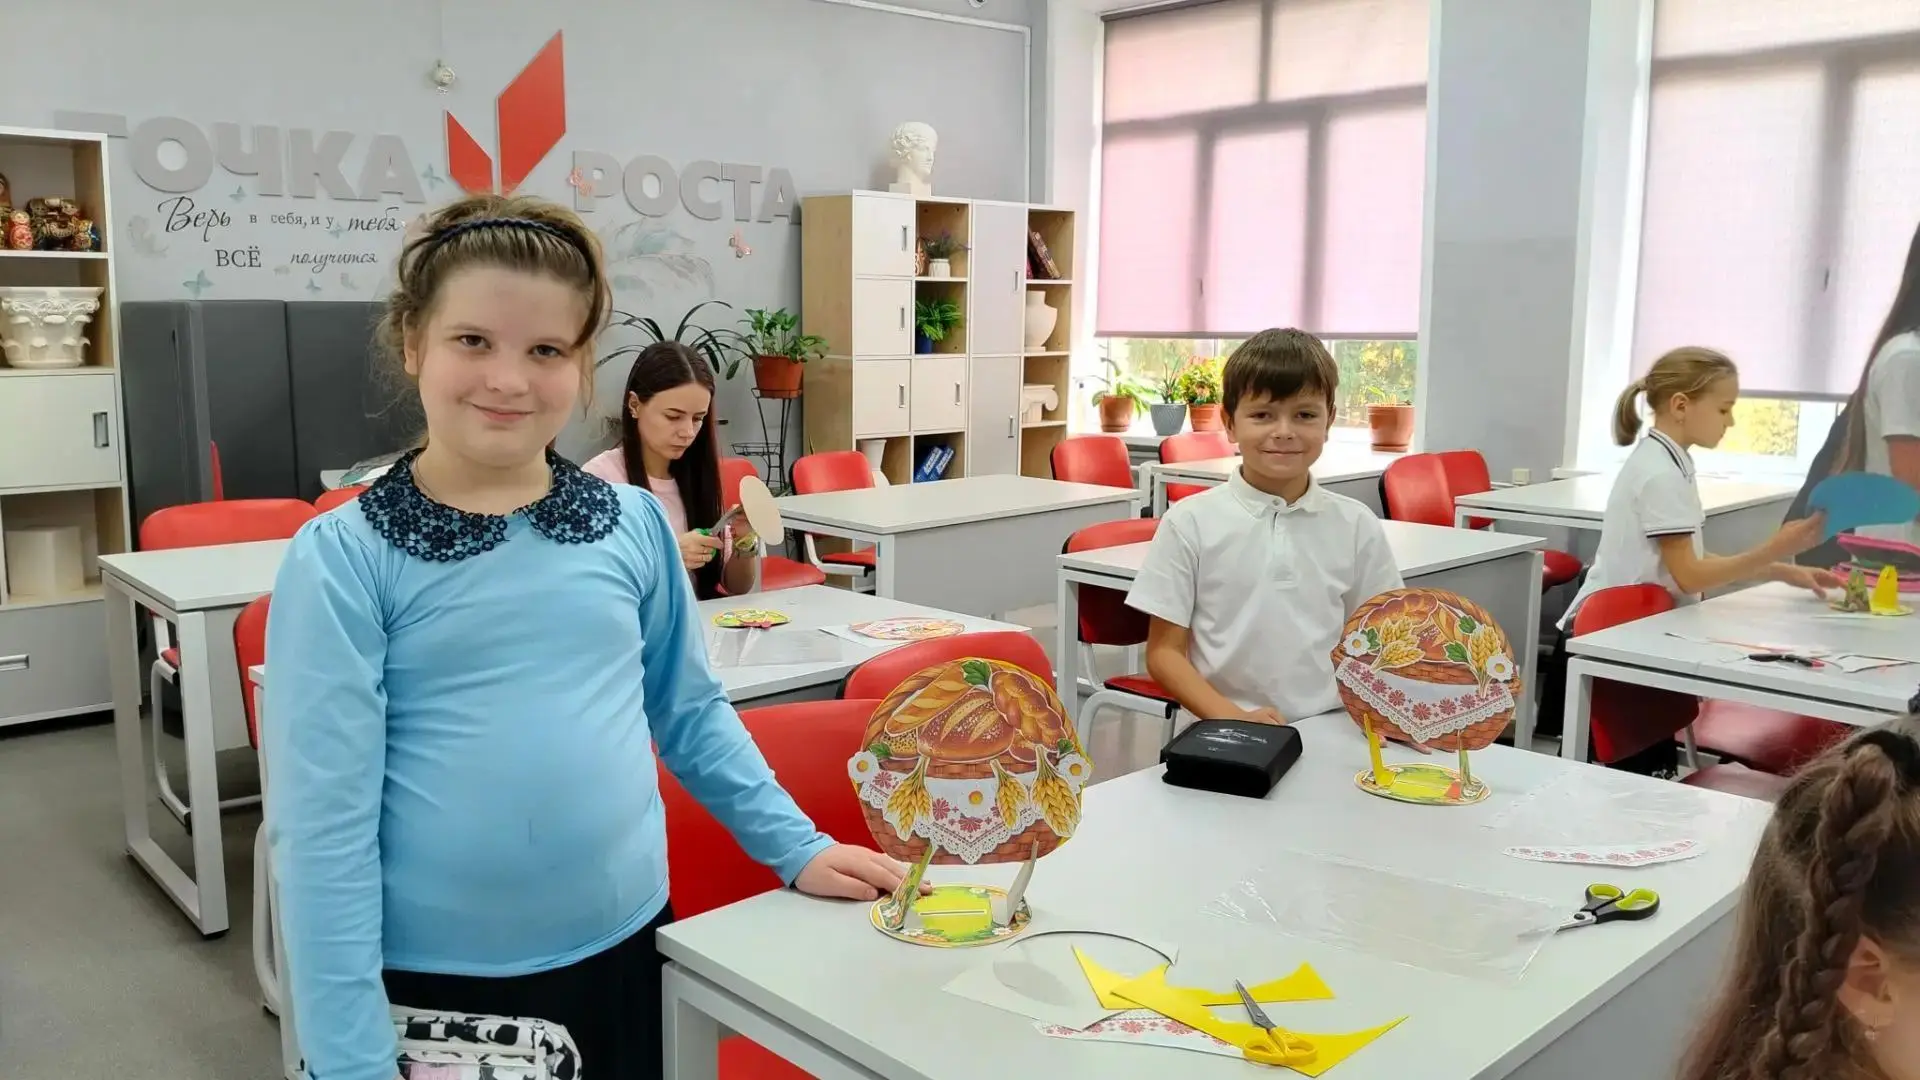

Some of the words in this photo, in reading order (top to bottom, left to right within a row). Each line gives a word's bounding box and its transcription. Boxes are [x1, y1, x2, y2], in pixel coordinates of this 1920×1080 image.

[572, 150, 801, 225] РОСТА
[157, 195, 231, 242] Верь
[249, 214, 258, 224] в
[270, 212, 308, 229] себя,
[311, 214, 321, 225] и
[325, 215, 335, 230] у
[347, 206, 401, 231] тебя
[215, 245, 262, 268] ВСЁ
[290, 252, 379, 274] получится
